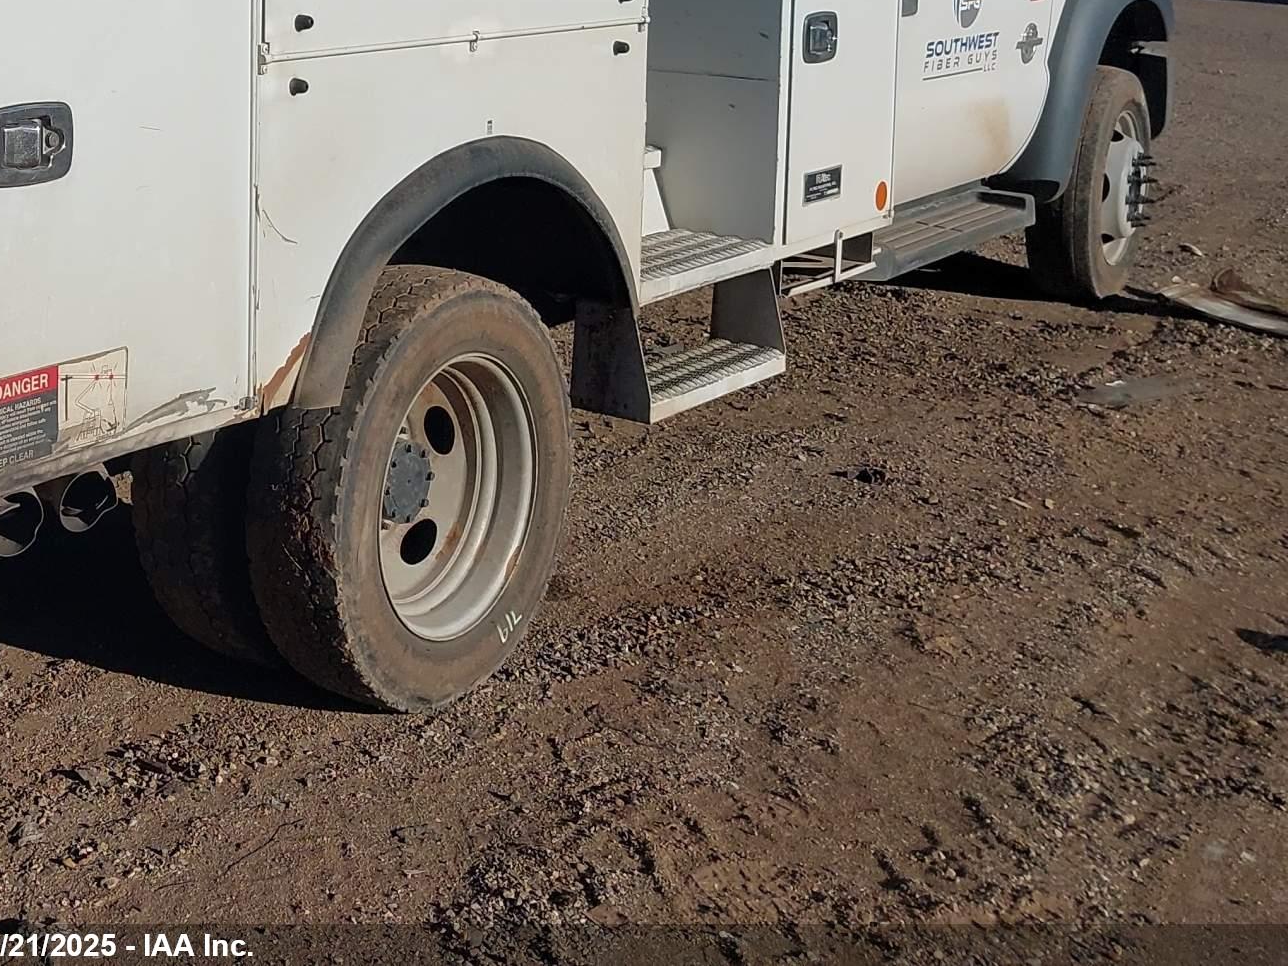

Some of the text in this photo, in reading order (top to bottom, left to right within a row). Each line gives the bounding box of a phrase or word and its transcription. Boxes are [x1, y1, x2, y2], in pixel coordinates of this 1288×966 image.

[925, 32, 1000, 58] SOUTHWEST
[923, 49, 998, 73] FIBER GUYS
[983, 63, 997, 72] LLC
[14, 397, 42, 410] HAZARDS
[9, 449, 34, 466] CLEAR
